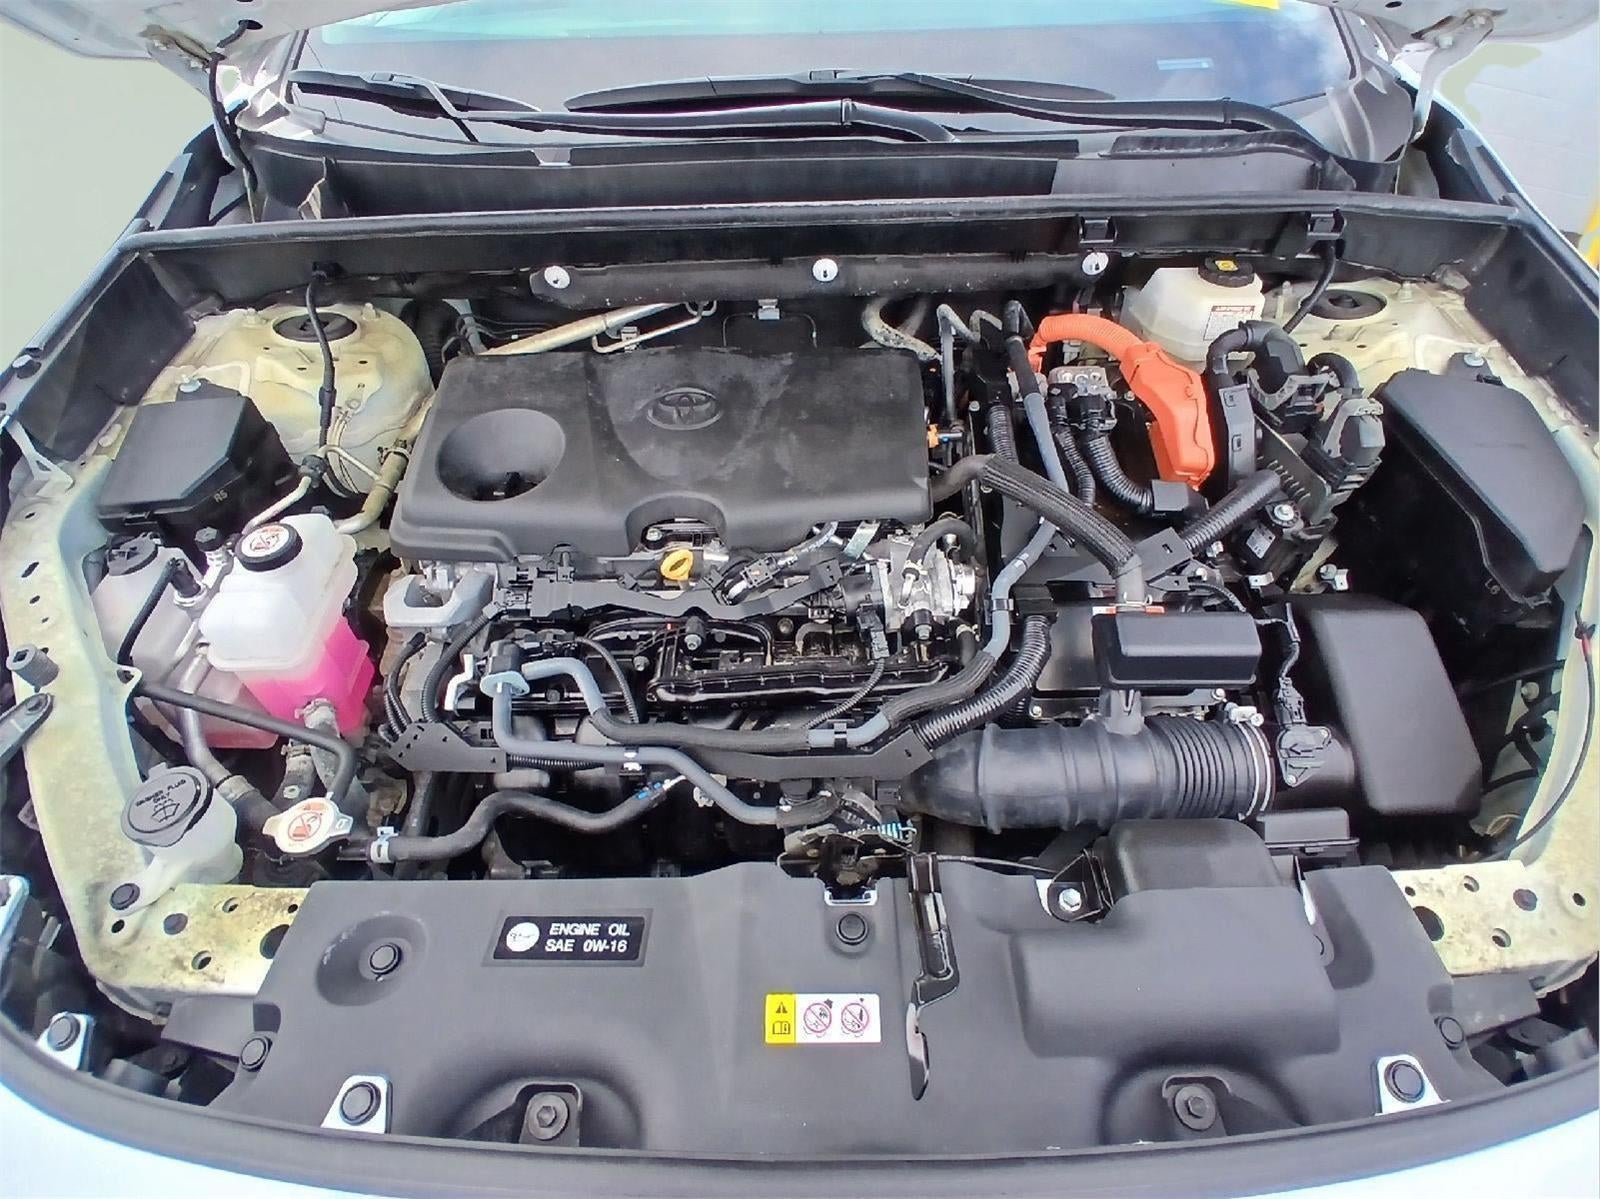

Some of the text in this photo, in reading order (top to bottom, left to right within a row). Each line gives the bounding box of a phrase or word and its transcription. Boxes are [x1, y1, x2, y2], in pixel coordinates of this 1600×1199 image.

[549, 922, 631, 937] ENGINE OIL
[544, 938, 627, 953] SAE 0W-16
